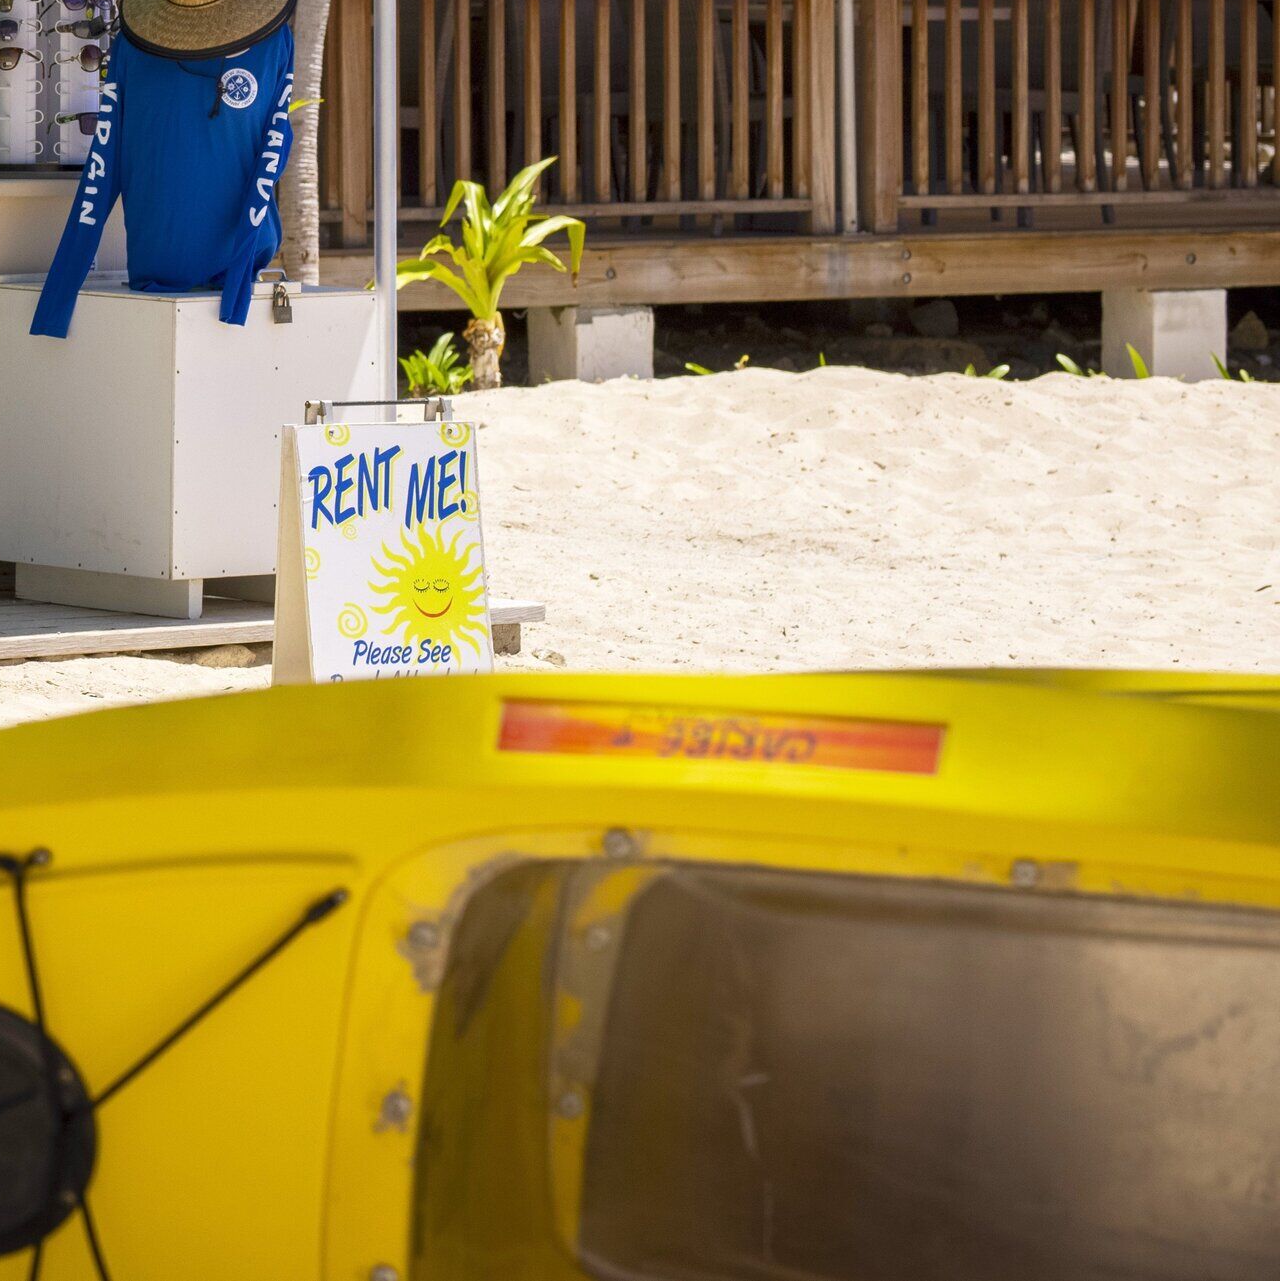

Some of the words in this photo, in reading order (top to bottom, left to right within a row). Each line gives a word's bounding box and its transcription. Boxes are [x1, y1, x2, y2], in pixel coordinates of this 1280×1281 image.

[78, 81, 118, 226] VIRGIN
[307, 445, 401, 530] RENT
[405, 450, 467, 530] ME!
[352, 639, 413, 666] Please
[417, 638, 452, 664] See
